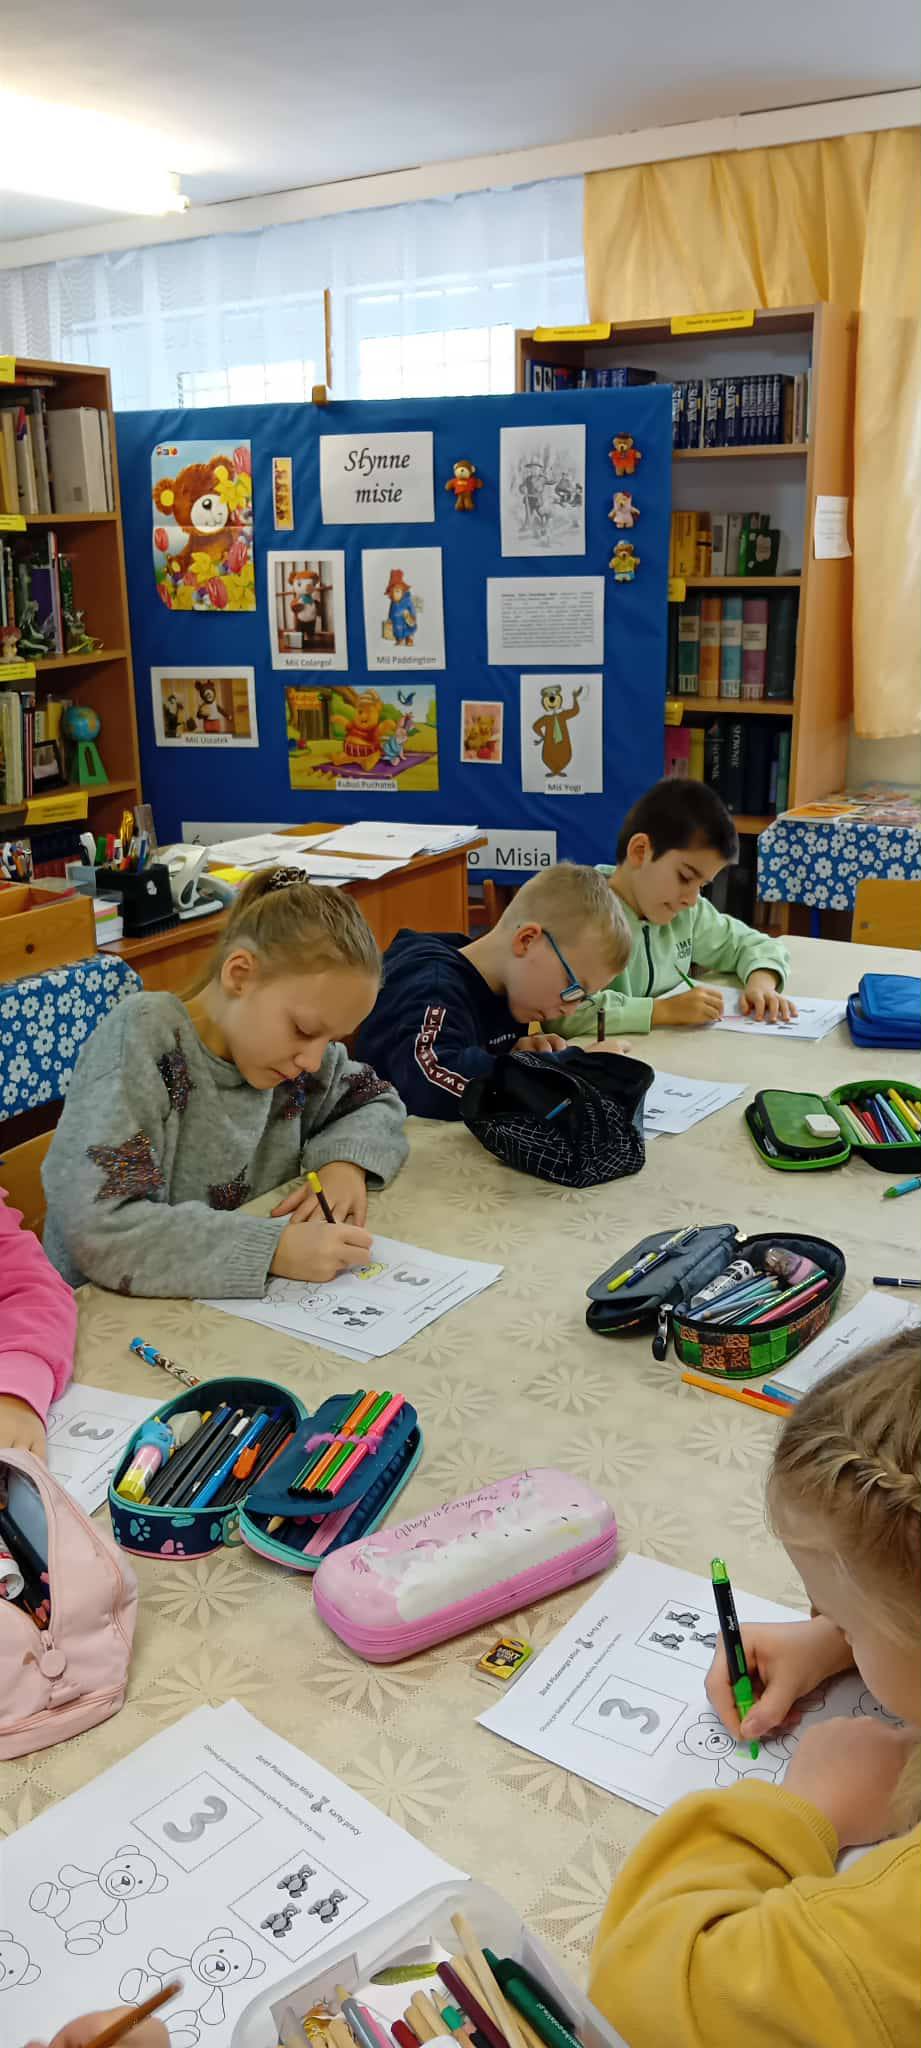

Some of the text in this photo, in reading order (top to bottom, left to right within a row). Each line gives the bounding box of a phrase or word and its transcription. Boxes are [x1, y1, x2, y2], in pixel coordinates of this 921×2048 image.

[344, 447, 411, 476] Słynne
[354, 485, 403, 504] misie
[285, 658, 299, 667] Miś
[376, 655, 437, 667] Miś Paddington
[185, 736, 199, 745] Miś
[361, 779, 396, 789] Puchatek
[547, 783, 581, 793] Miś Yogi
[495, 847, 551, 867] Misia
[598, 1698, 660, 1735] 3
[162, 1795, 228, 1843] 3
